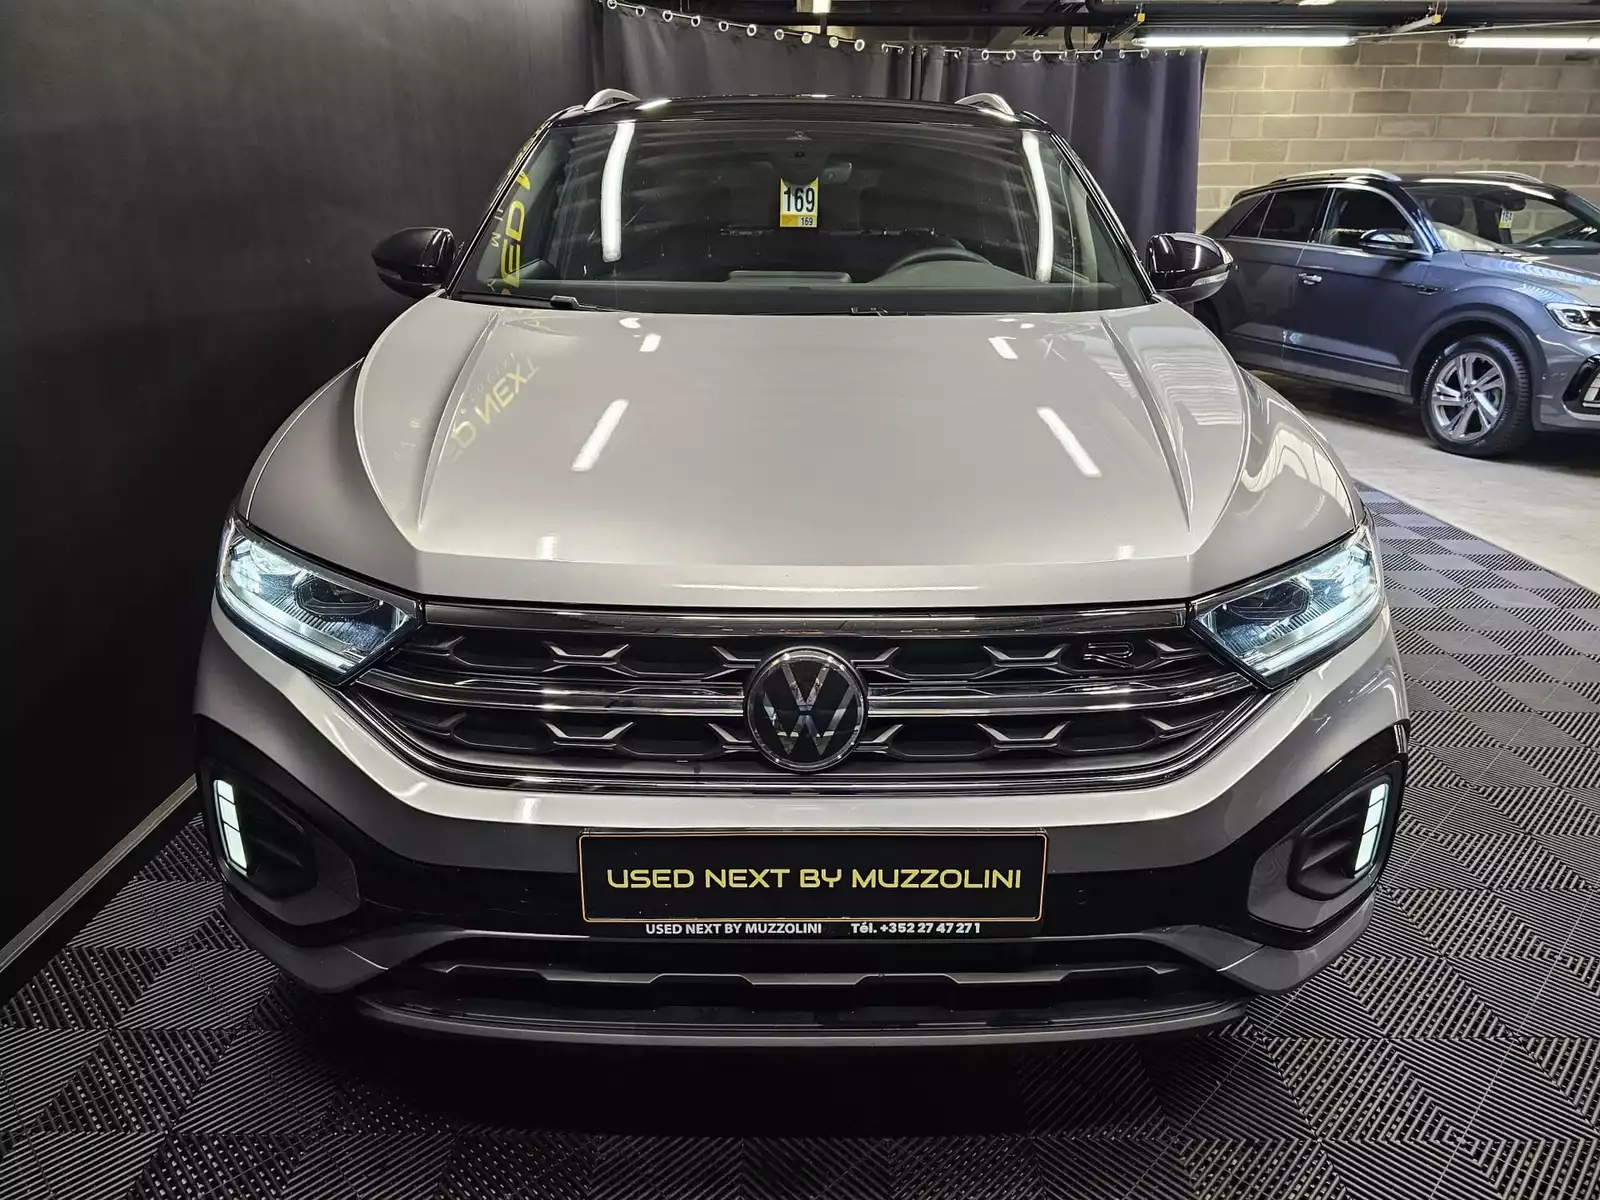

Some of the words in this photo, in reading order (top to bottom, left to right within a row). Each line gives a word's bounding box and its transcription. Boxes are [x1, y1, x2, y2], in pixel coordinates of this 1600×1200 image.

[784, 187, 815, 212] 169
[801, 217, 813, 226] 169
[607, 868, 695, 889] USED
[705, 868, 790, 889] NEXT
[800, 868, 842, 889] BY
[852, 868, 1021, 889] MUZZOLINI
[645, 924, 683, 935] USED
[686, 924, 721, 934] NEXT
[725, 923, 742, 934] BY
[745, 923, 822, 934] MUZZOLINI
[851, 921, 878, 934] Tél.
[880, 922, 915, 934] +352
[917, 922, 934, 934] 27
[936, 922, 954, 934] 47
